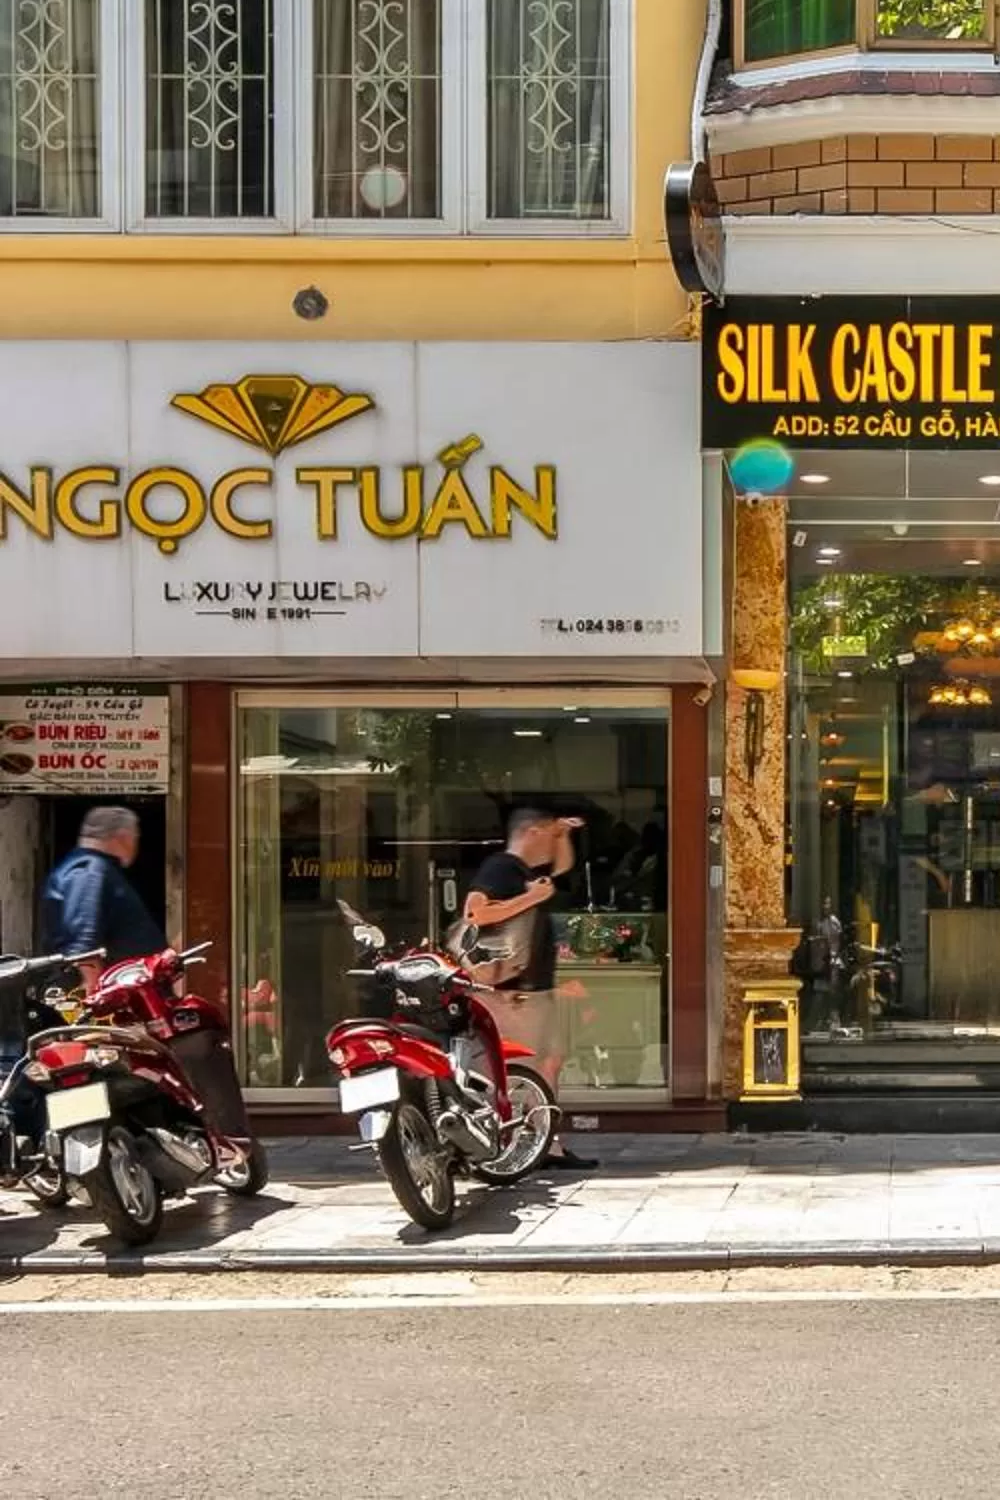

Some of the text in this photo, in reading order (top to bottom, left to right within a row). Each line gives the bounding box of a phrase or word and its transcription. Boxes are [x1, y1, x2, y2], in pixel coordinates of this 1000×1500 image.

[717, 322, 820, 403] SILK
[831, 321, 994, 404] CASTLE
[773, 416, 830, 437] ADD:
[833, 415, 860, 437] 52
[864, 409, 912, 438] CẦU
[0, 465, 275, 555] NGỌC
